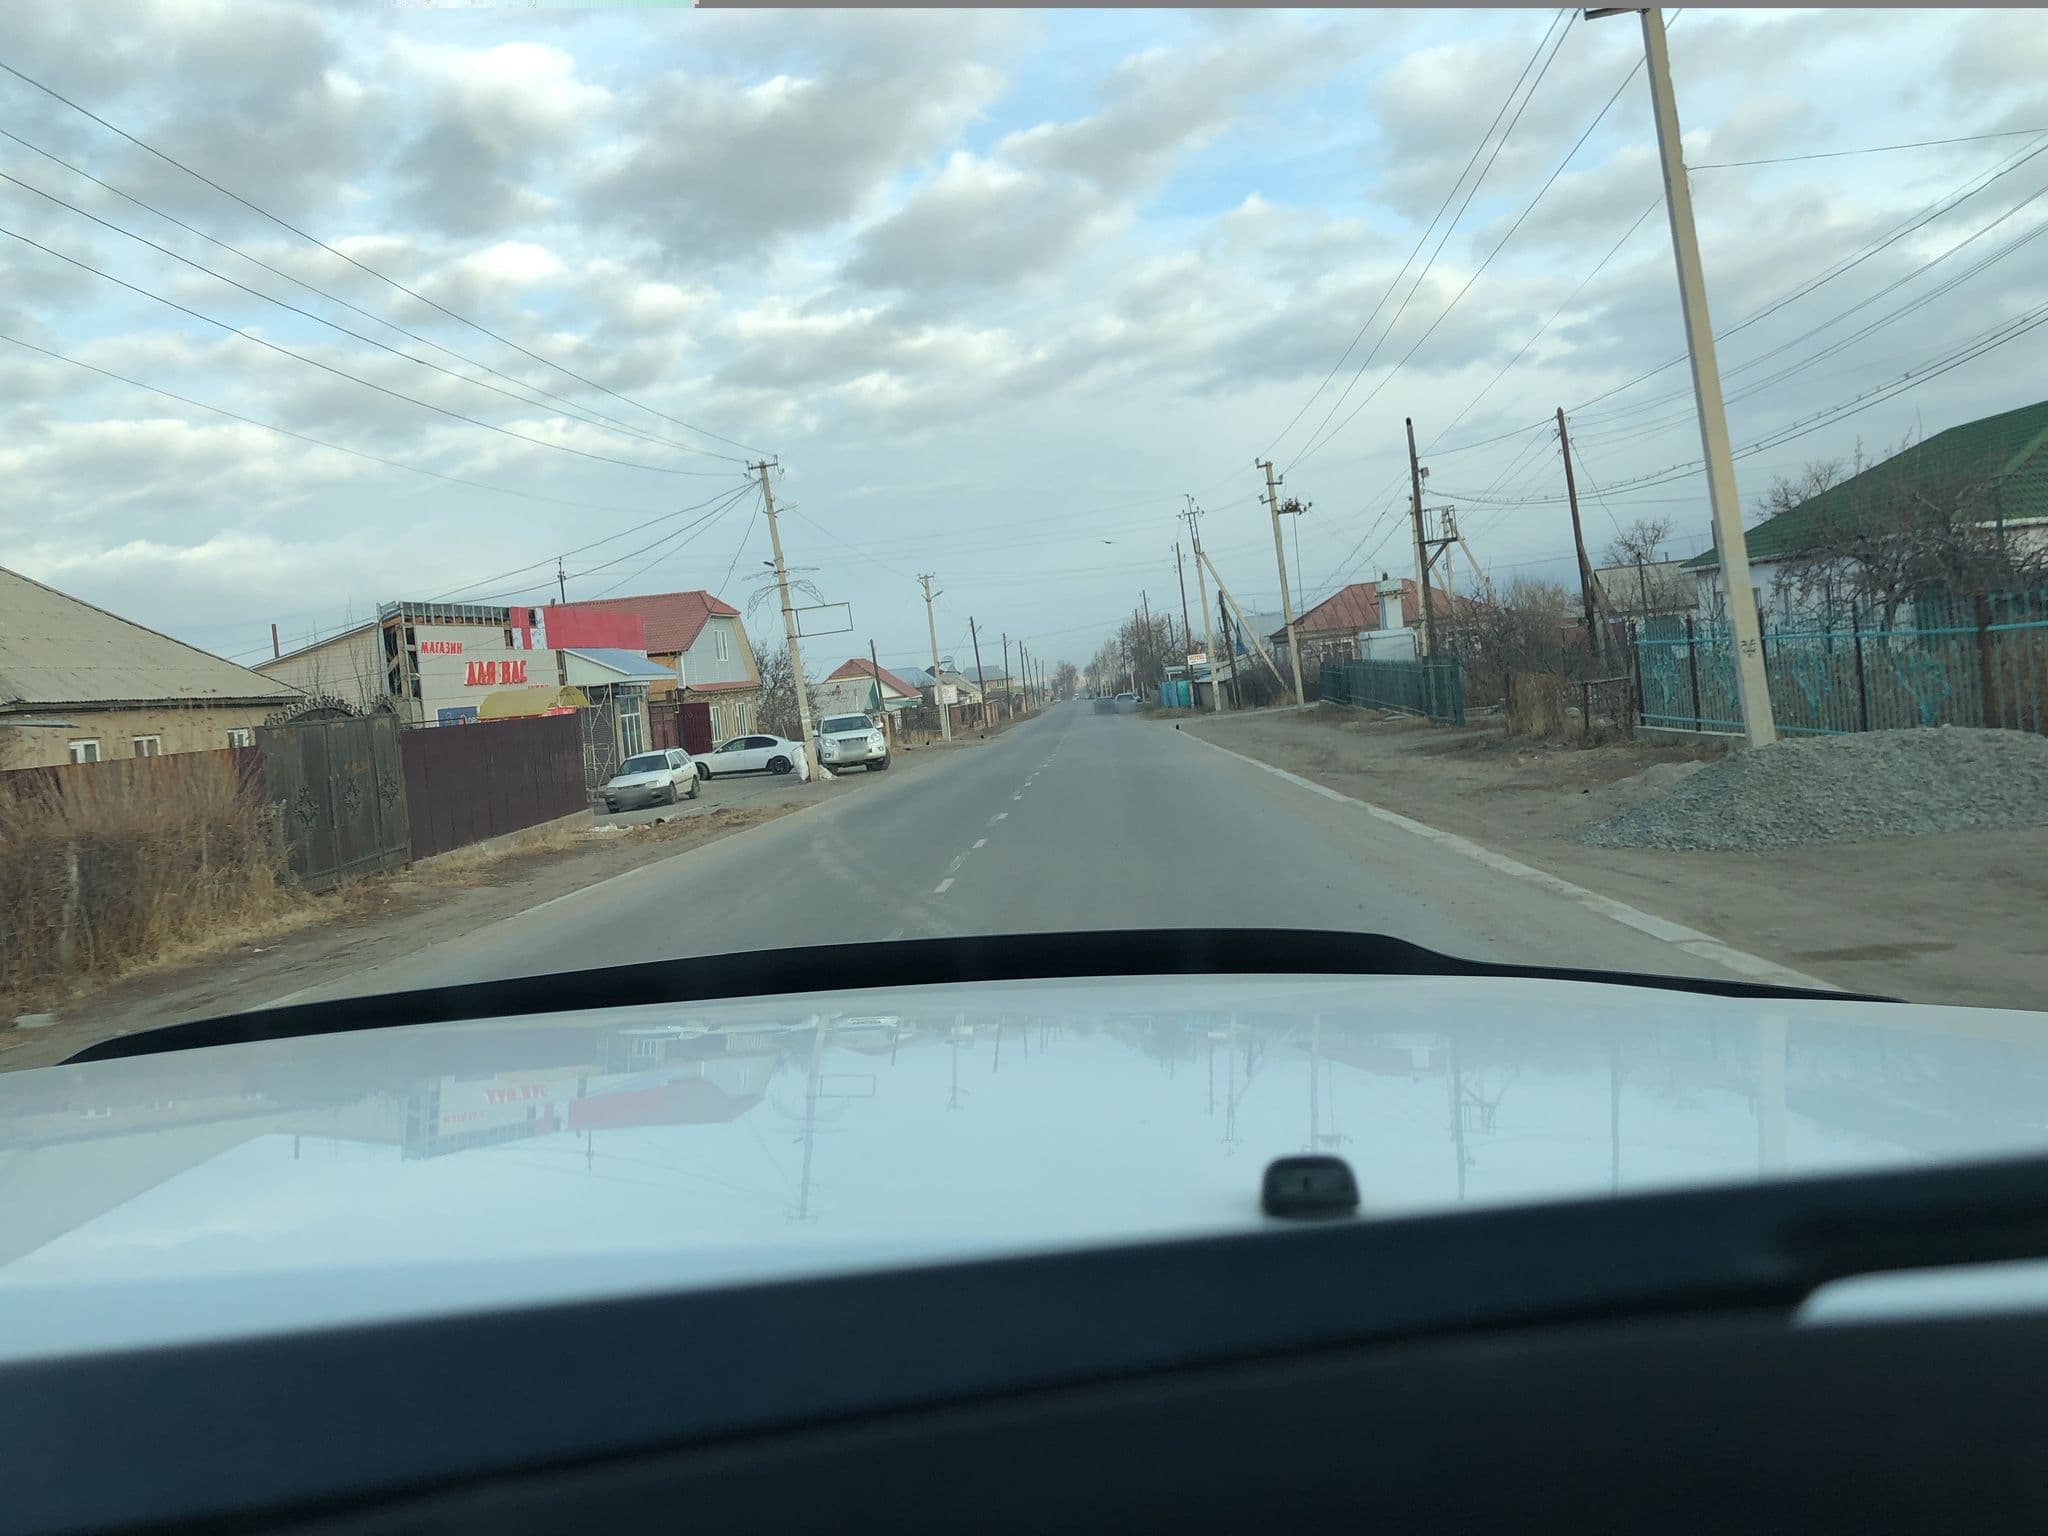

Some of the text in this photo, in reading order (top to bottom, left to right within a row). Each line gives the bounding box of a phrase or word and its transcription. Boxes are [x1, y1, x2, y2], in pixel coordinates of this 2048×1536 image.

[421, 641, 463, 654] МАГАЗИН
[464, 660, 528, 686] ДЛЯ ВАС
